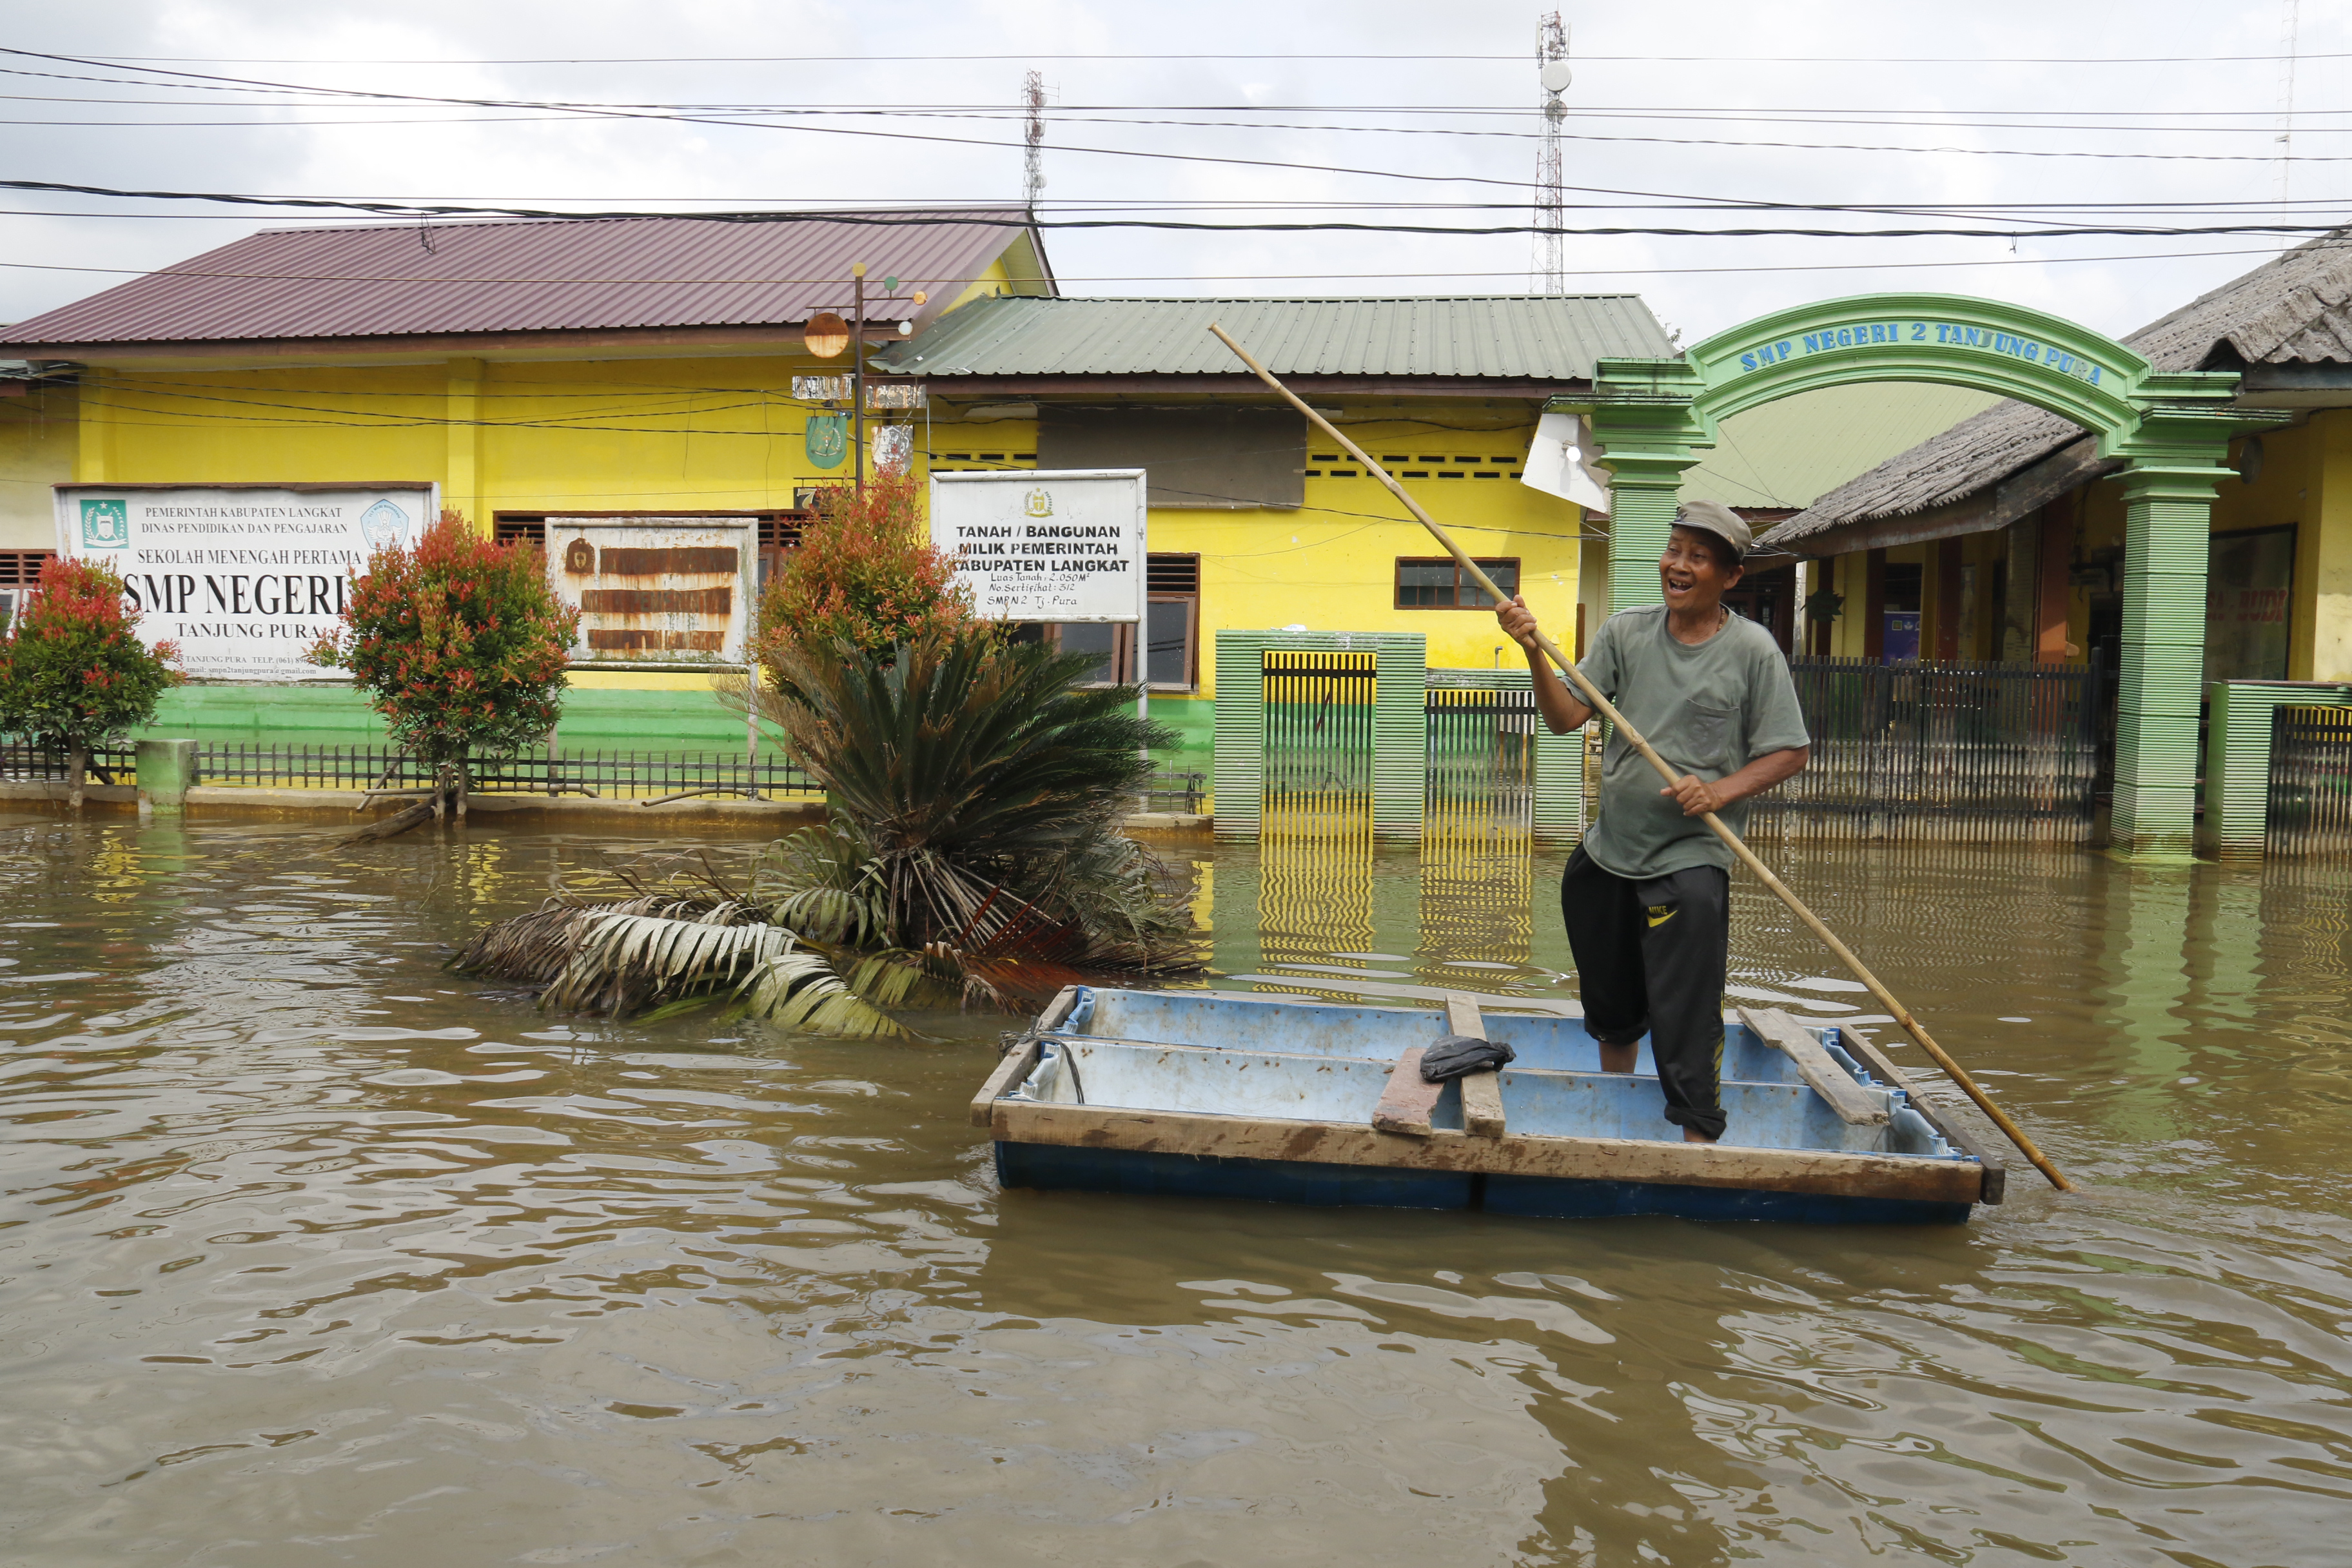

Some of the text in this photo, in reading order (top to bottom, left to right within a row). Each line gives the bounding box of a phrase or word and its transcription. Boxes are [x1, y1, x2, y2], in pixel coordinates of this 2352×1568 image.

[1740, 322, 2102, 386] SMP NEGERI 2 TANJUNG PURA
[145, 507, 342, 518] PEMERINTAH KABUPATEN LANGKAT
[141, 523, 348, 534] DINAS PENDIDIKAN DAN PENGAJARAN
[956, 525, 1120, 538] TANAH / BANGUNAN
[959, 542, 1118, 556] MILIK PEMERINTAH
[138, 549, 362, 565] SEKOLAH MENENGAH PERTAMA
[1052, 560, 1130, 572] LANGKAT
[991, 573, 1014, 582] Luas
[124, 573, 346, 615] SMP NEGERI
[1052, 595, 1077, 605] Pura
[175, 623, 320, 638] TANJUNG PURA
[208, 667, 317, 676] smpn2tanjungpura@gmail.com
[1649, 905, 1668, 916] NIKE
